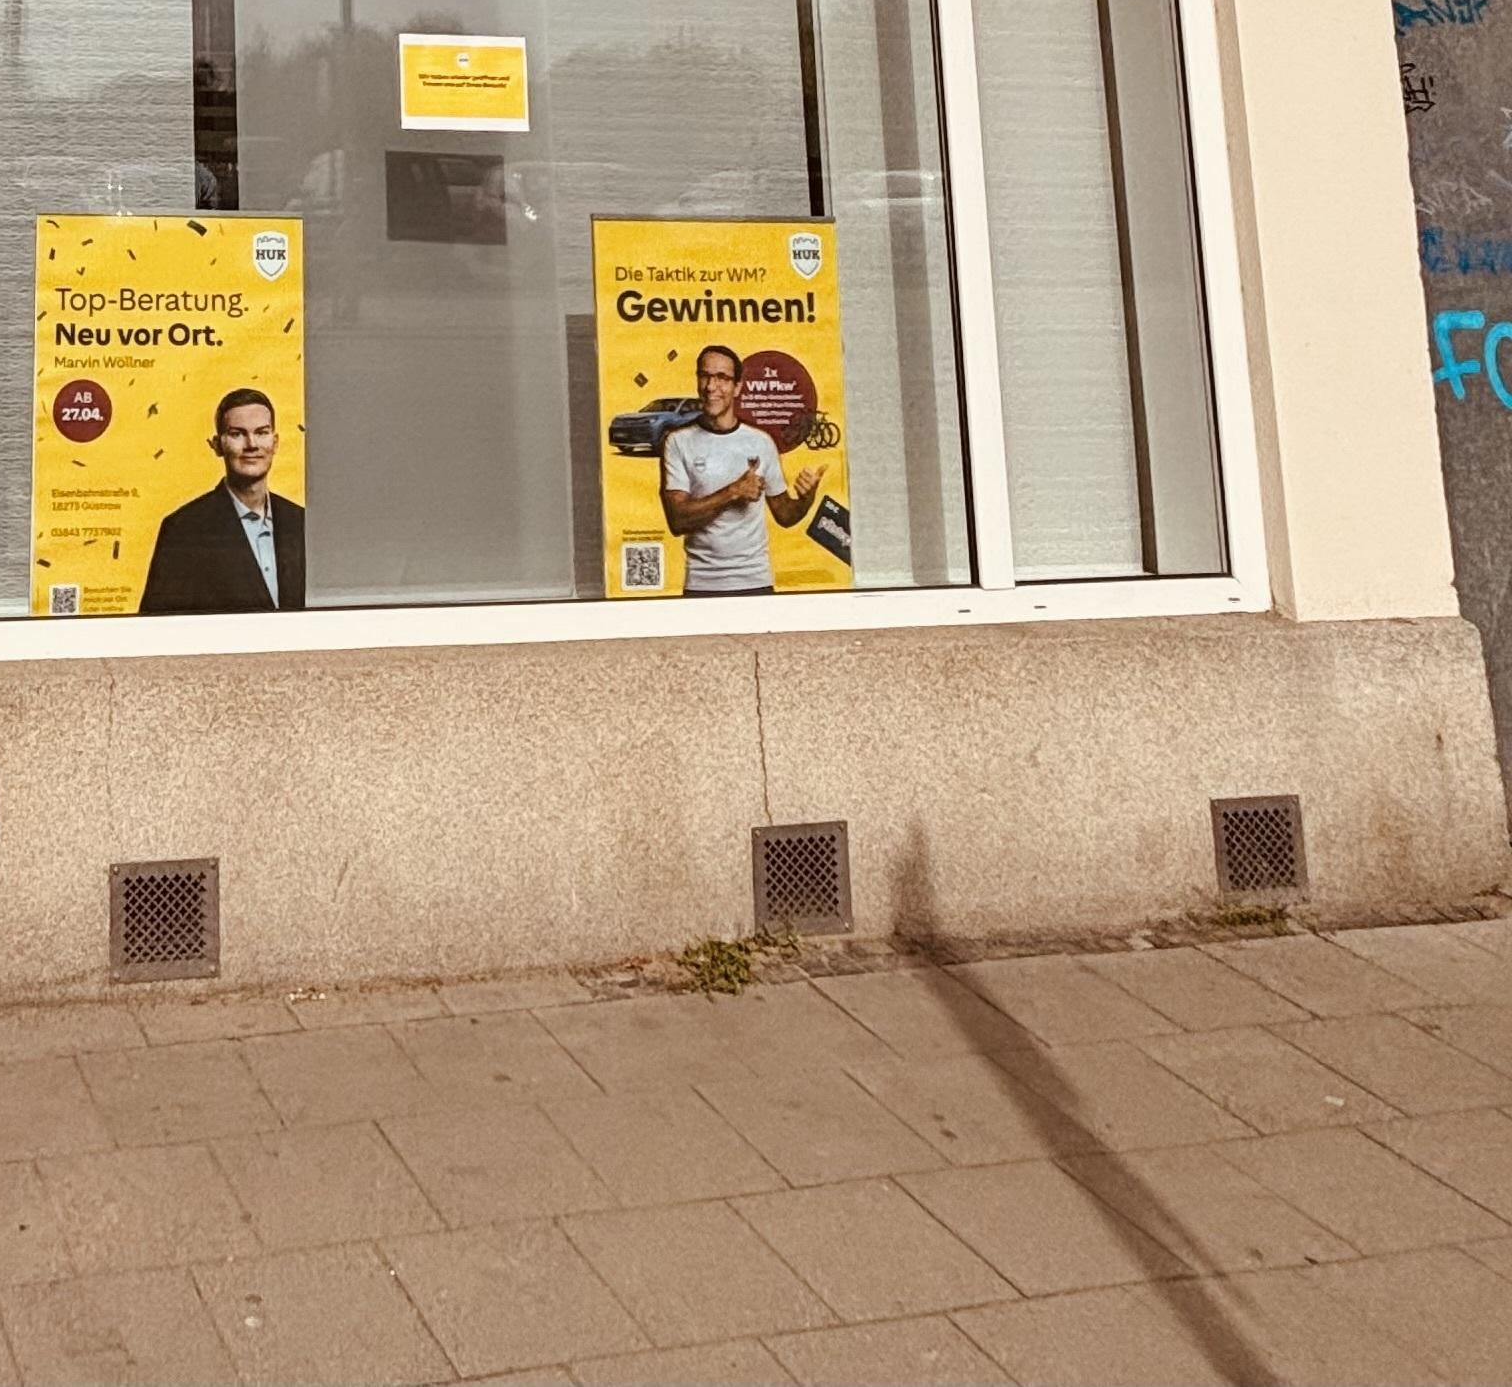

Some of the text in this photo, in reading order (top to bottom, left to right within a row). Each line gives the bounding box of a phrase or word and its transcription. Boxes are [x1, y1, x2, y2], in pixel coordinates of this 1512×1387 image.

[255, 249, 286, 261] HUK
[792, 249, 820, 261] HUK
[615, 266, 766, 283] Die Taktik zur WM?
[54, 288, 249, 318] Top-Beratung.
[616, 289, 816, 323] Gewinnen!
[55, 322, 224, 347] Neu vor Ort.
[54, 356, 100, 369] Marvin
[745, 380, 768, 391] VW
[74, 392, 93, 404] AB
[61, 408, 104, 422] 27.04.
